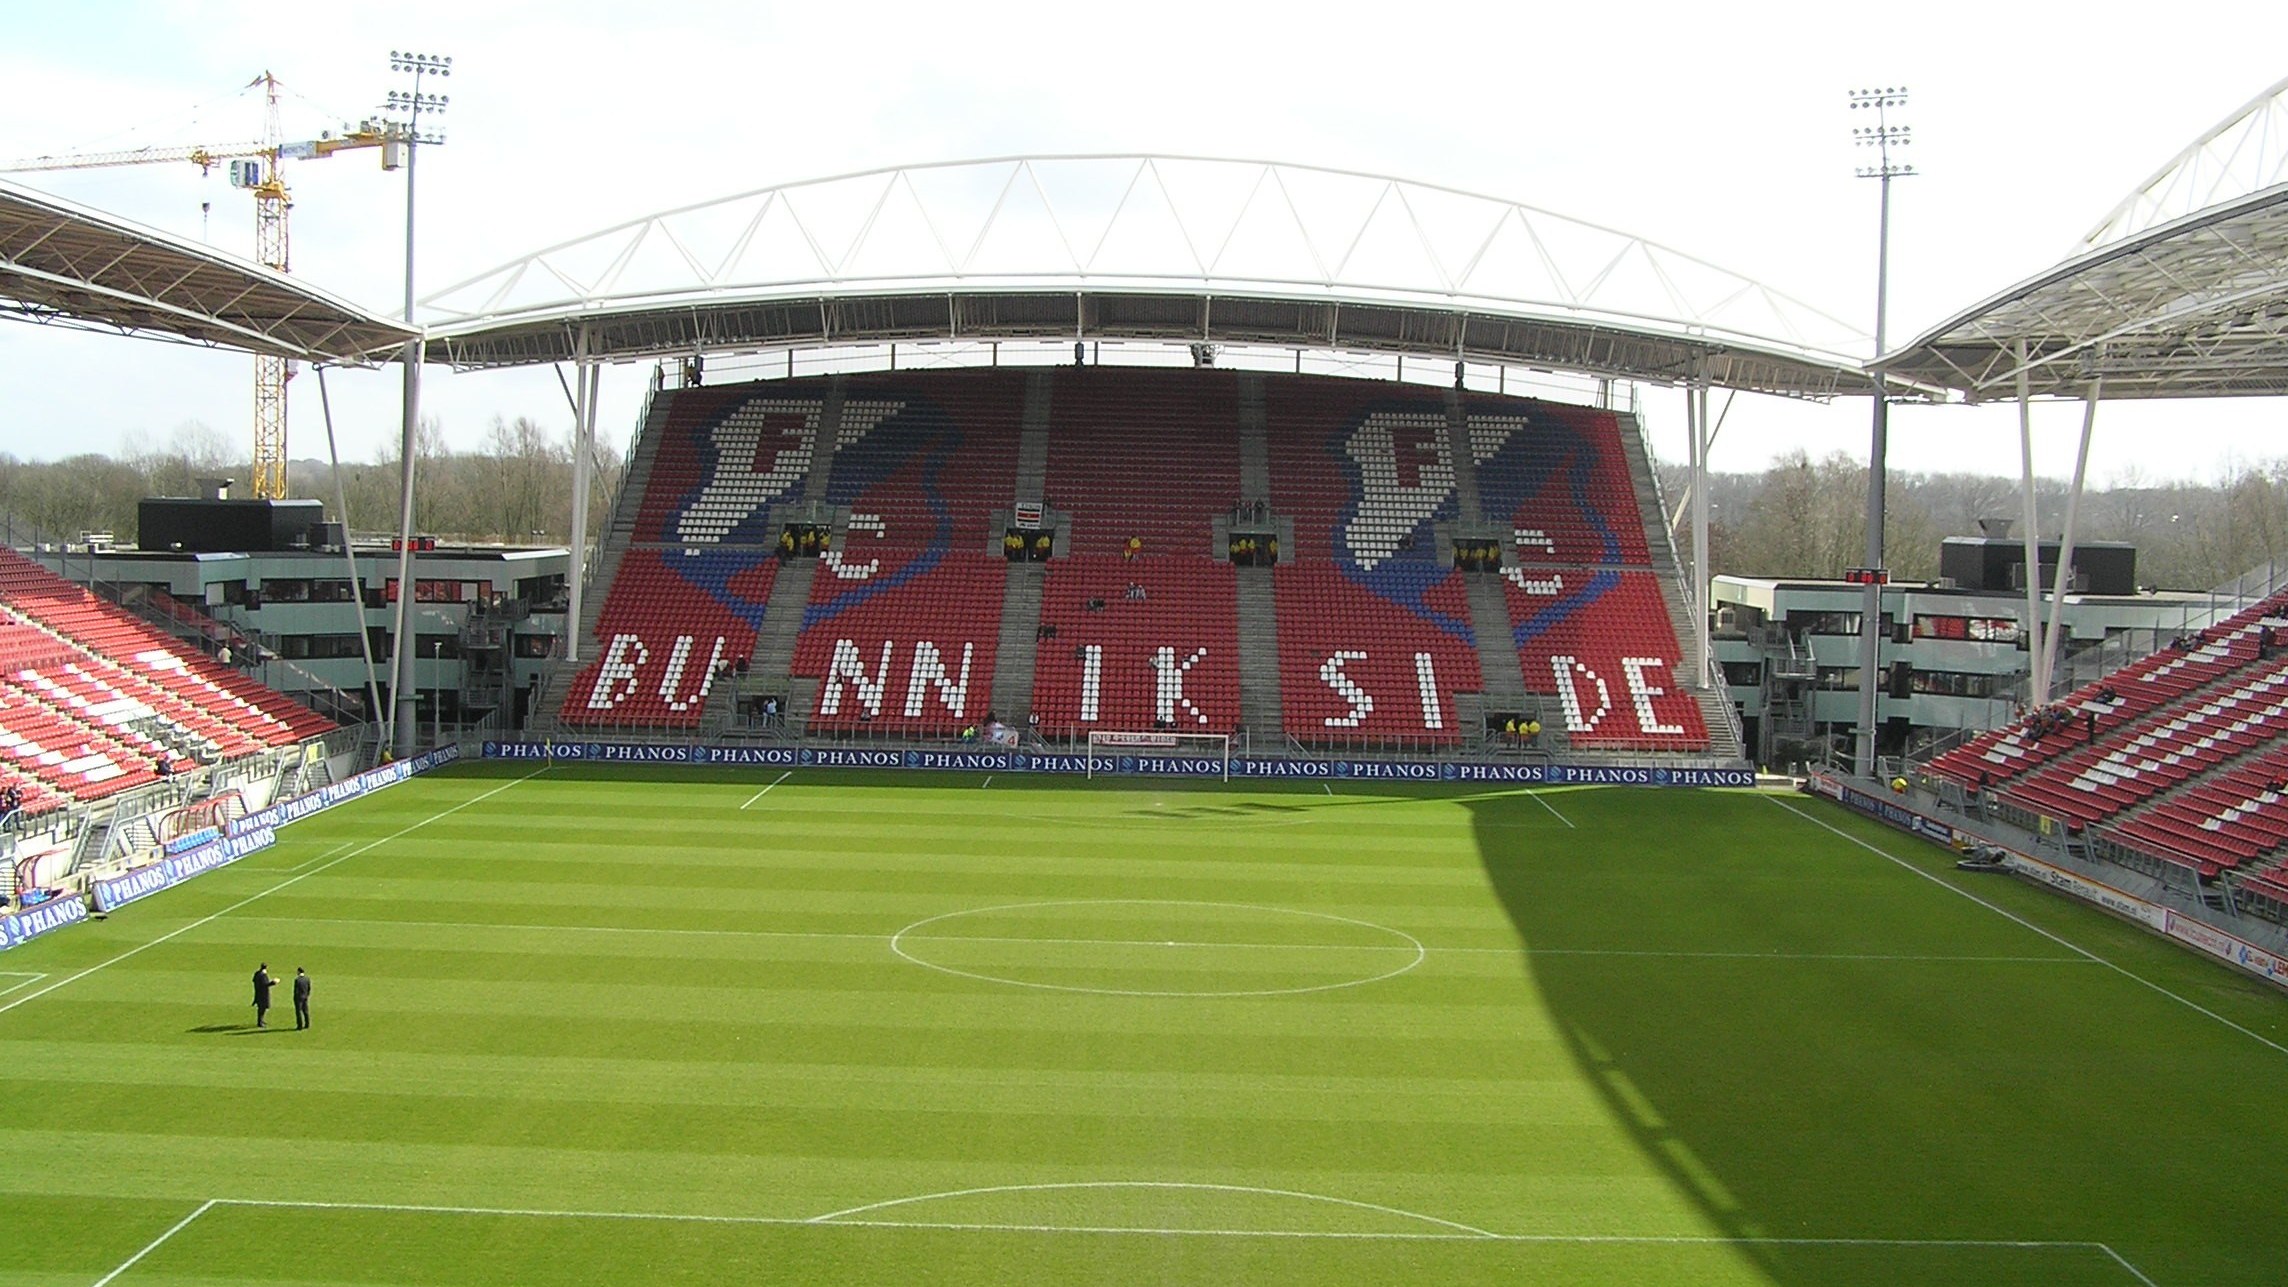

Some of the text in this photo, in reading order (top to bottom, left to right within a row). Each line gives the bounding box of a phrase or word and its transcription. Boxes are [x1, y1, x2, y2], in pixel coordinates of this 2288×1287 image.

[501, 743, 582, 758] PHANOS
[606, 746, 687, 761] PHANOS
[710, 748, 793, 763] PHANOS
[817, 751, 899, 765] PHANOS
[924, 753, 1006, 768] PHANOS
[1031, 756, 1114, 771] PHANOS
[1138, 759, 1221, 773] PHANOS
[1246, 761, 1329, 775] PHANOS
[367, 767, 397, 789] PHANOS
[1353, 763, 1436, 778] PHANOS
[1460, 765, 1542, 780] PHANOS
[1566, 768, 1648, 783] PHANOS
[1672, 770, 1753, 784] PHANOS
[328, 777, 361, 802] PHANOS
[287, 793, 322, 820] PHANOS
[239, 808, 280, 831] PHANOS
[232, 826, 275, 856] PHANOS
[175, 845, 223, 878] PHANOS
[112, 866, 166, 901] PHANOS
[20, 897, 87, 936] PHANOS
